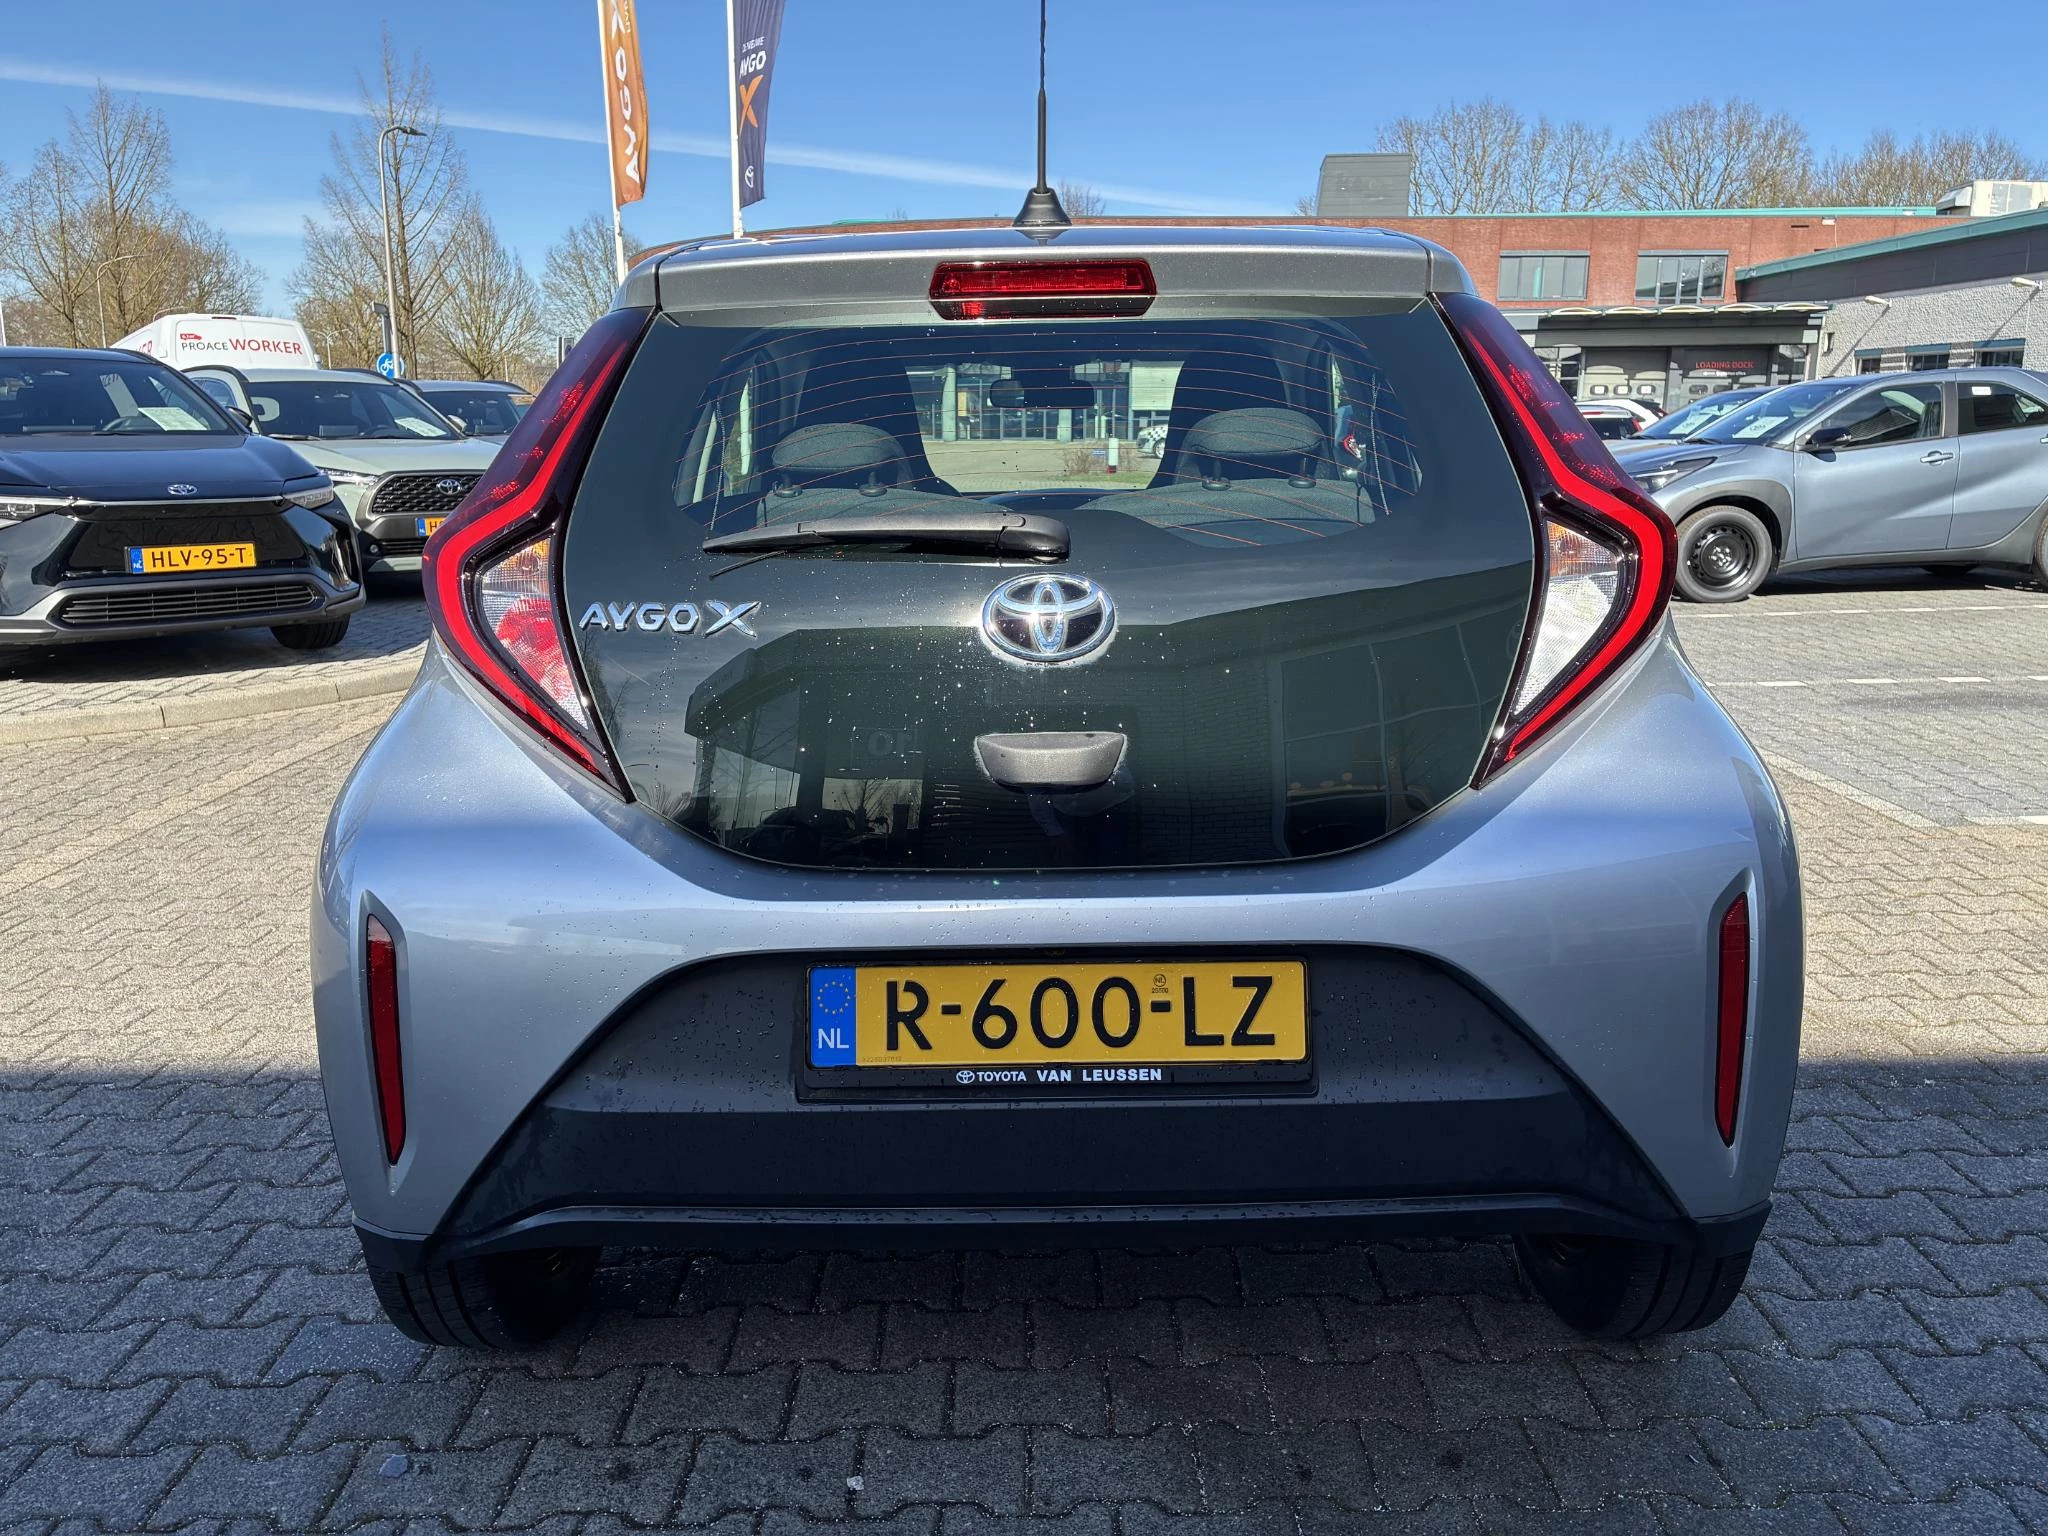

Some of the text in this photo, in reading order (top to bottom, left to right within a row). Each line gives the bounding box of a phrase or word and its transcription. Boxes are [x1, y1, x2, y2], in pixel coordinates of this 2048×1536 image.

[739, 50, 767, 79] AYGO
[615, 46, 641, 185] AYGO
[739, 74, 764, 138] X
[181, 338, 303, 355] PROACE WORKER
[1695, 360, 1756, 369] LOADING DOCK
[151, 547, 247, 569] HLV-95-T
[579, 599, 762, 639] AYGO X
[885, 975, 1276, 1051] R-600-LZ
[817, 1027, 850, 1049] NL
[976, 1068, 1162, 1082] TOYOTA VAN LEUSSEN
